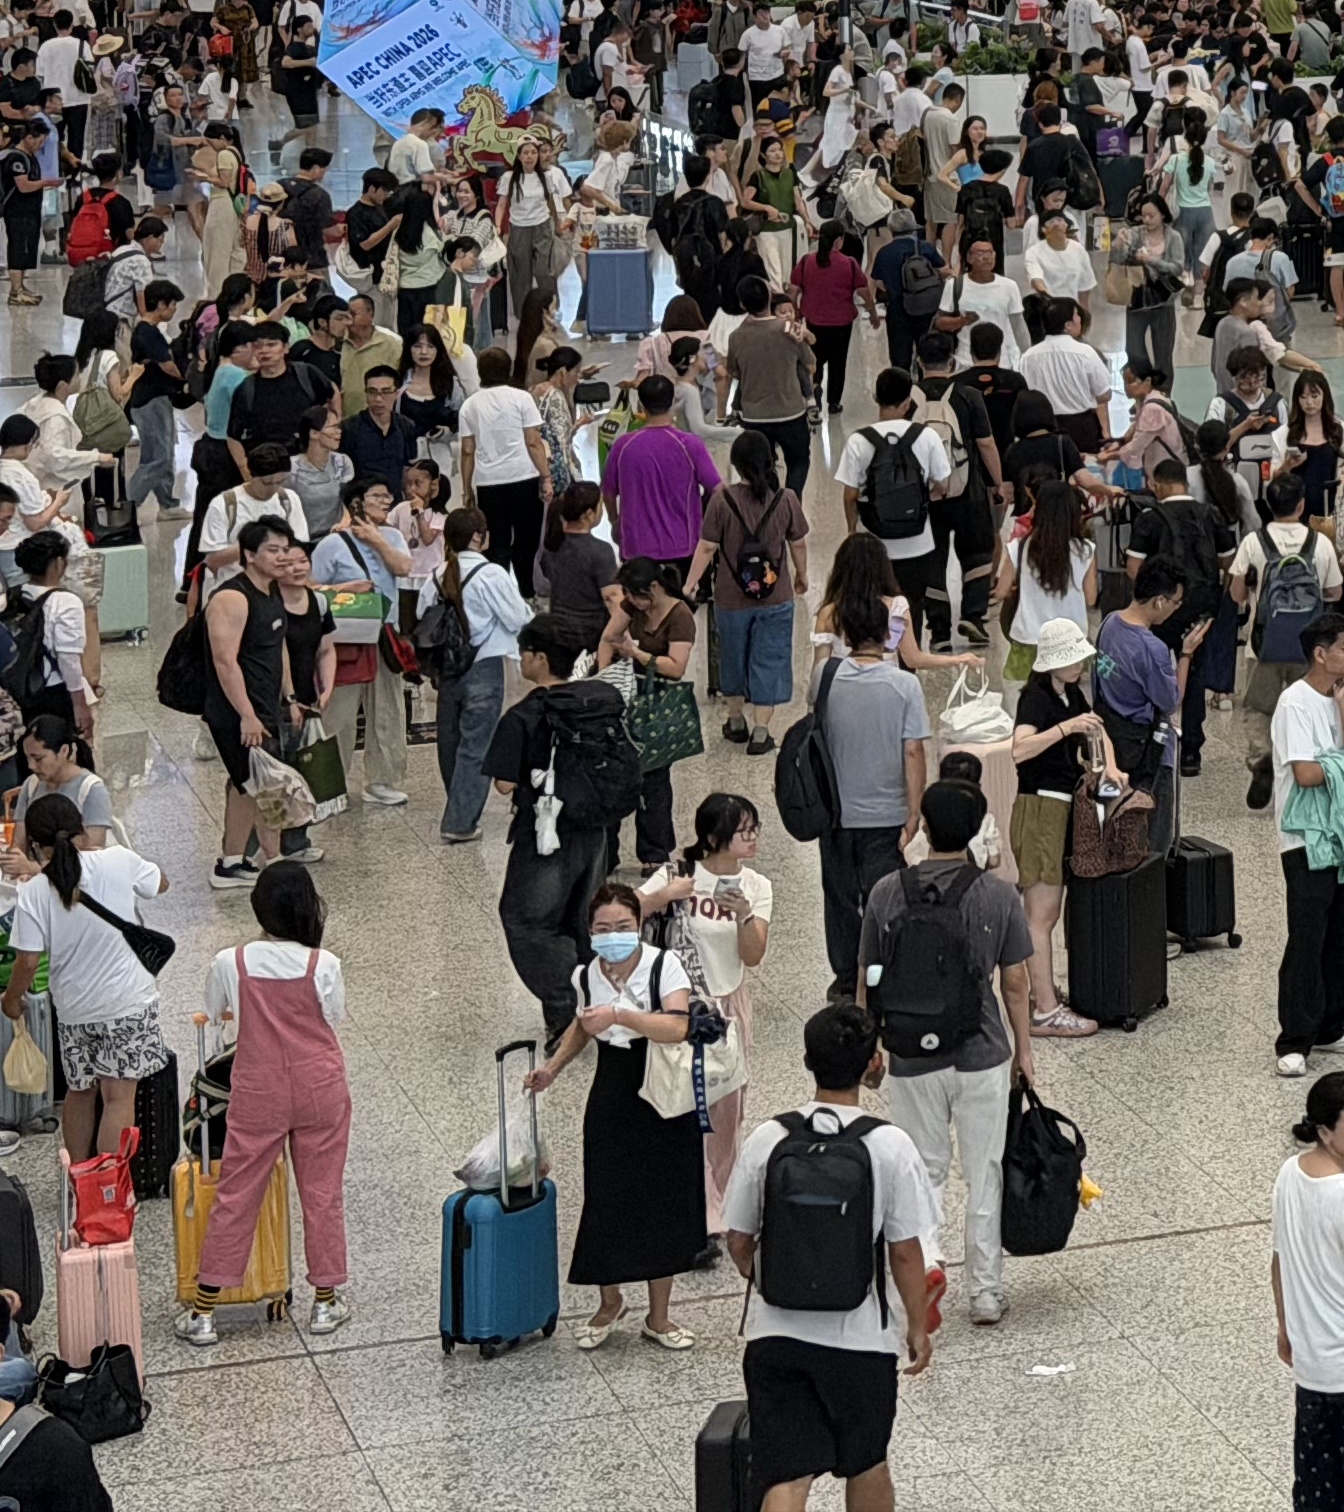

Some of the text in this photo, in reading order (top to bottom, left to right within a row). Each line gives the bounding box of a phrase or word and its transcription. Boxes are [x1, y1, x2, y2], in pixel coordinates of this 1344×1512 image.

[345, 23, 440, 90] APEC CHINA 2026
